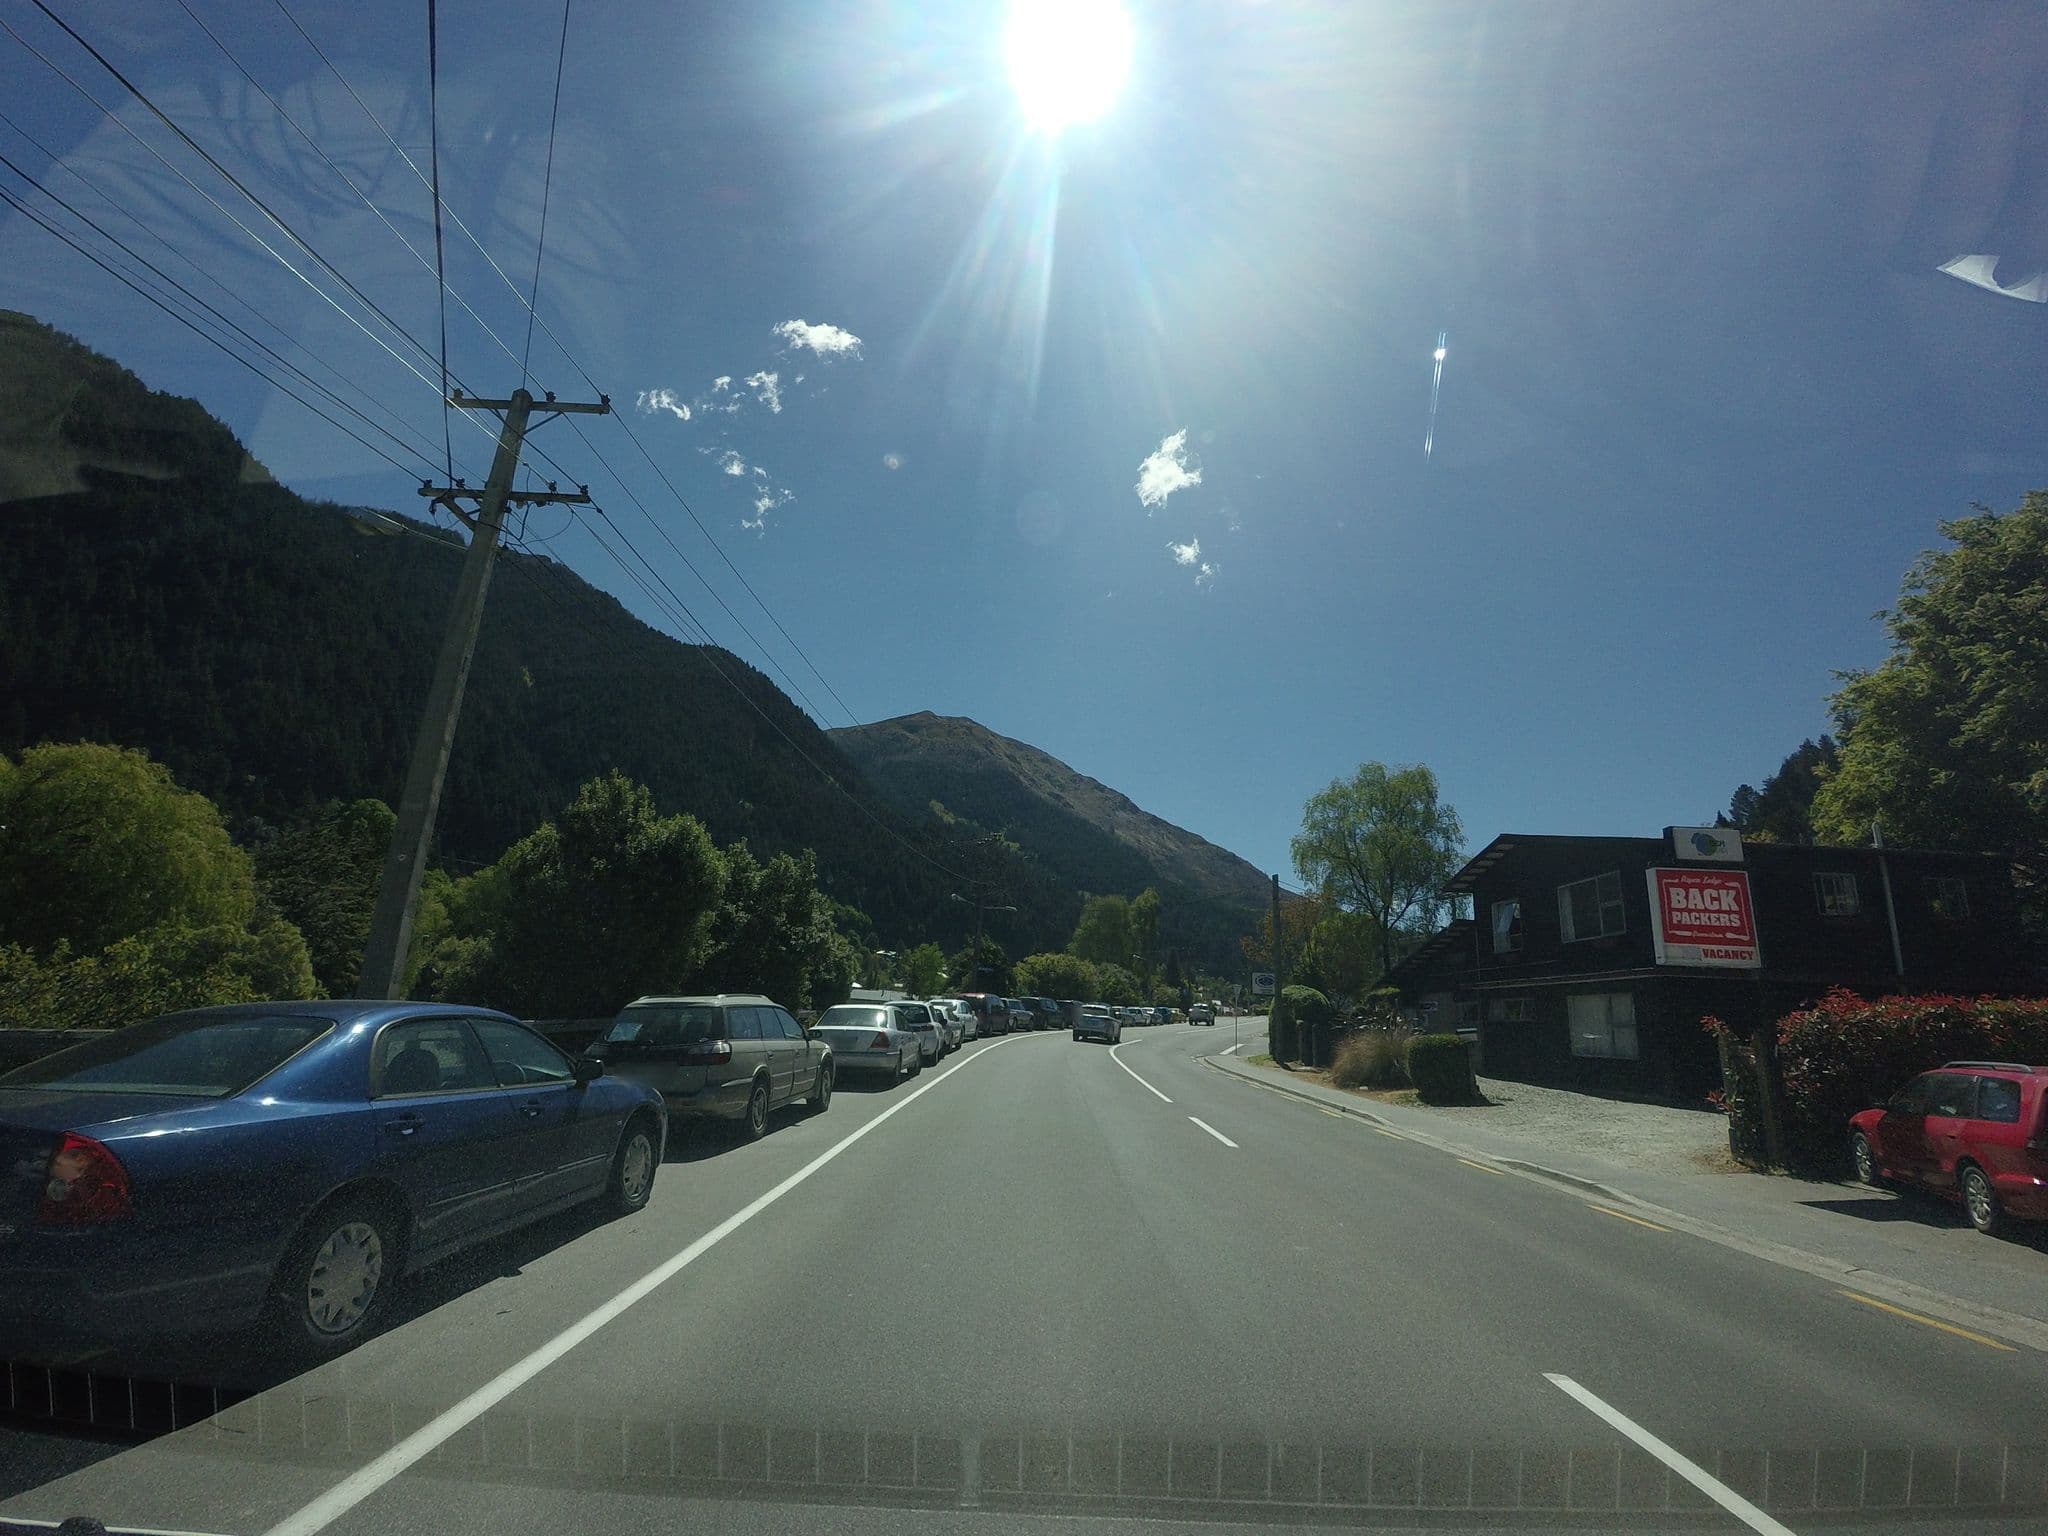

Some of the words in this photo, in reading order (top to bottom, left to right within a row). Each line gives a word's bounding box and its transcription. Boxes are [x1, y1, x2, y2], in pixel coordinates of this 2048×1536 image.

[1669, 887, 1740, 911] BACK
[1671, 911, 1741, 927] PACKERS
[1701, 948, 1754, 960] VACANCY
